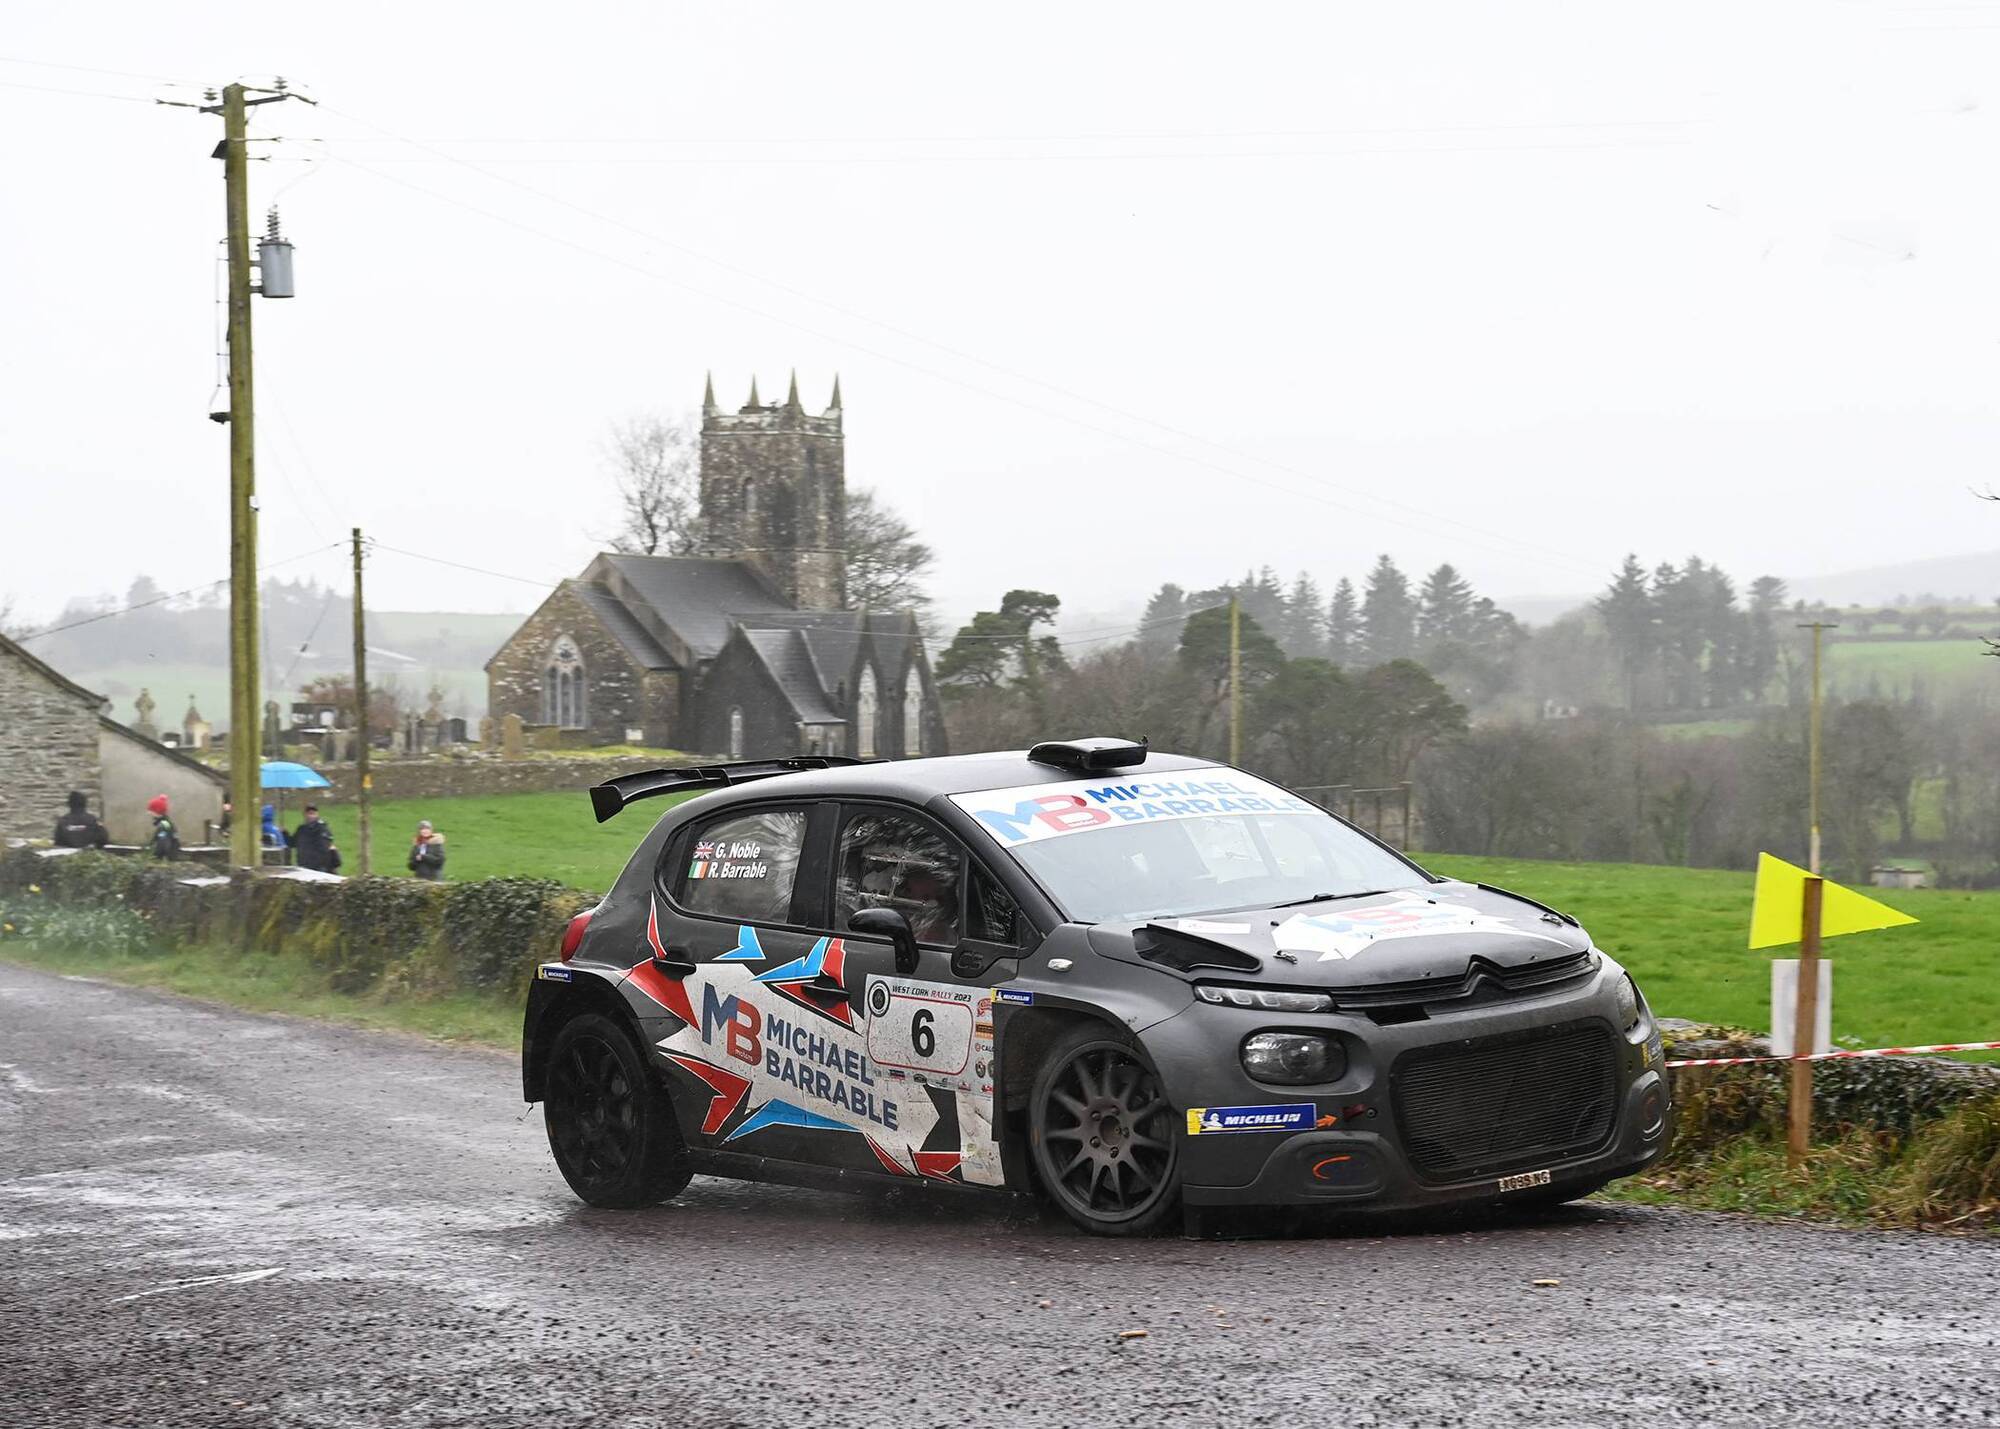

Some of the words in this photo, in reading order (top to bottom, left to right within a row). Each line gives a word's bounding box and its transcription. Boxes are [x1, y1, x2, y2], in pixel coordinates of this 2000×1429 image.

[1085, 780, 1257, 803] MICHAEL
[1109, 797, 1312, 822] BARRABLE
[715, 842, 726, 859] G.
[728, 842, 761, 859] Noble
[708, 861, 719, 878] R.
[721, 861, 767, 878] Barrable
[891, 985, 909, 994] WEST
[911, 987, 929, 997] CORK
[930, 990, 952, 1000] RALLY
[953, 993, 971, 1002] 2023
[702, 982, 762, 1066] MB
[912, 1008, 935, 1058] 6
[766, 1013, 875, 1086] MICHAEL
[766, 1048, 898, 1131] BARRABLE
[1224, 1113, 1301, 1125] MICHELIN
